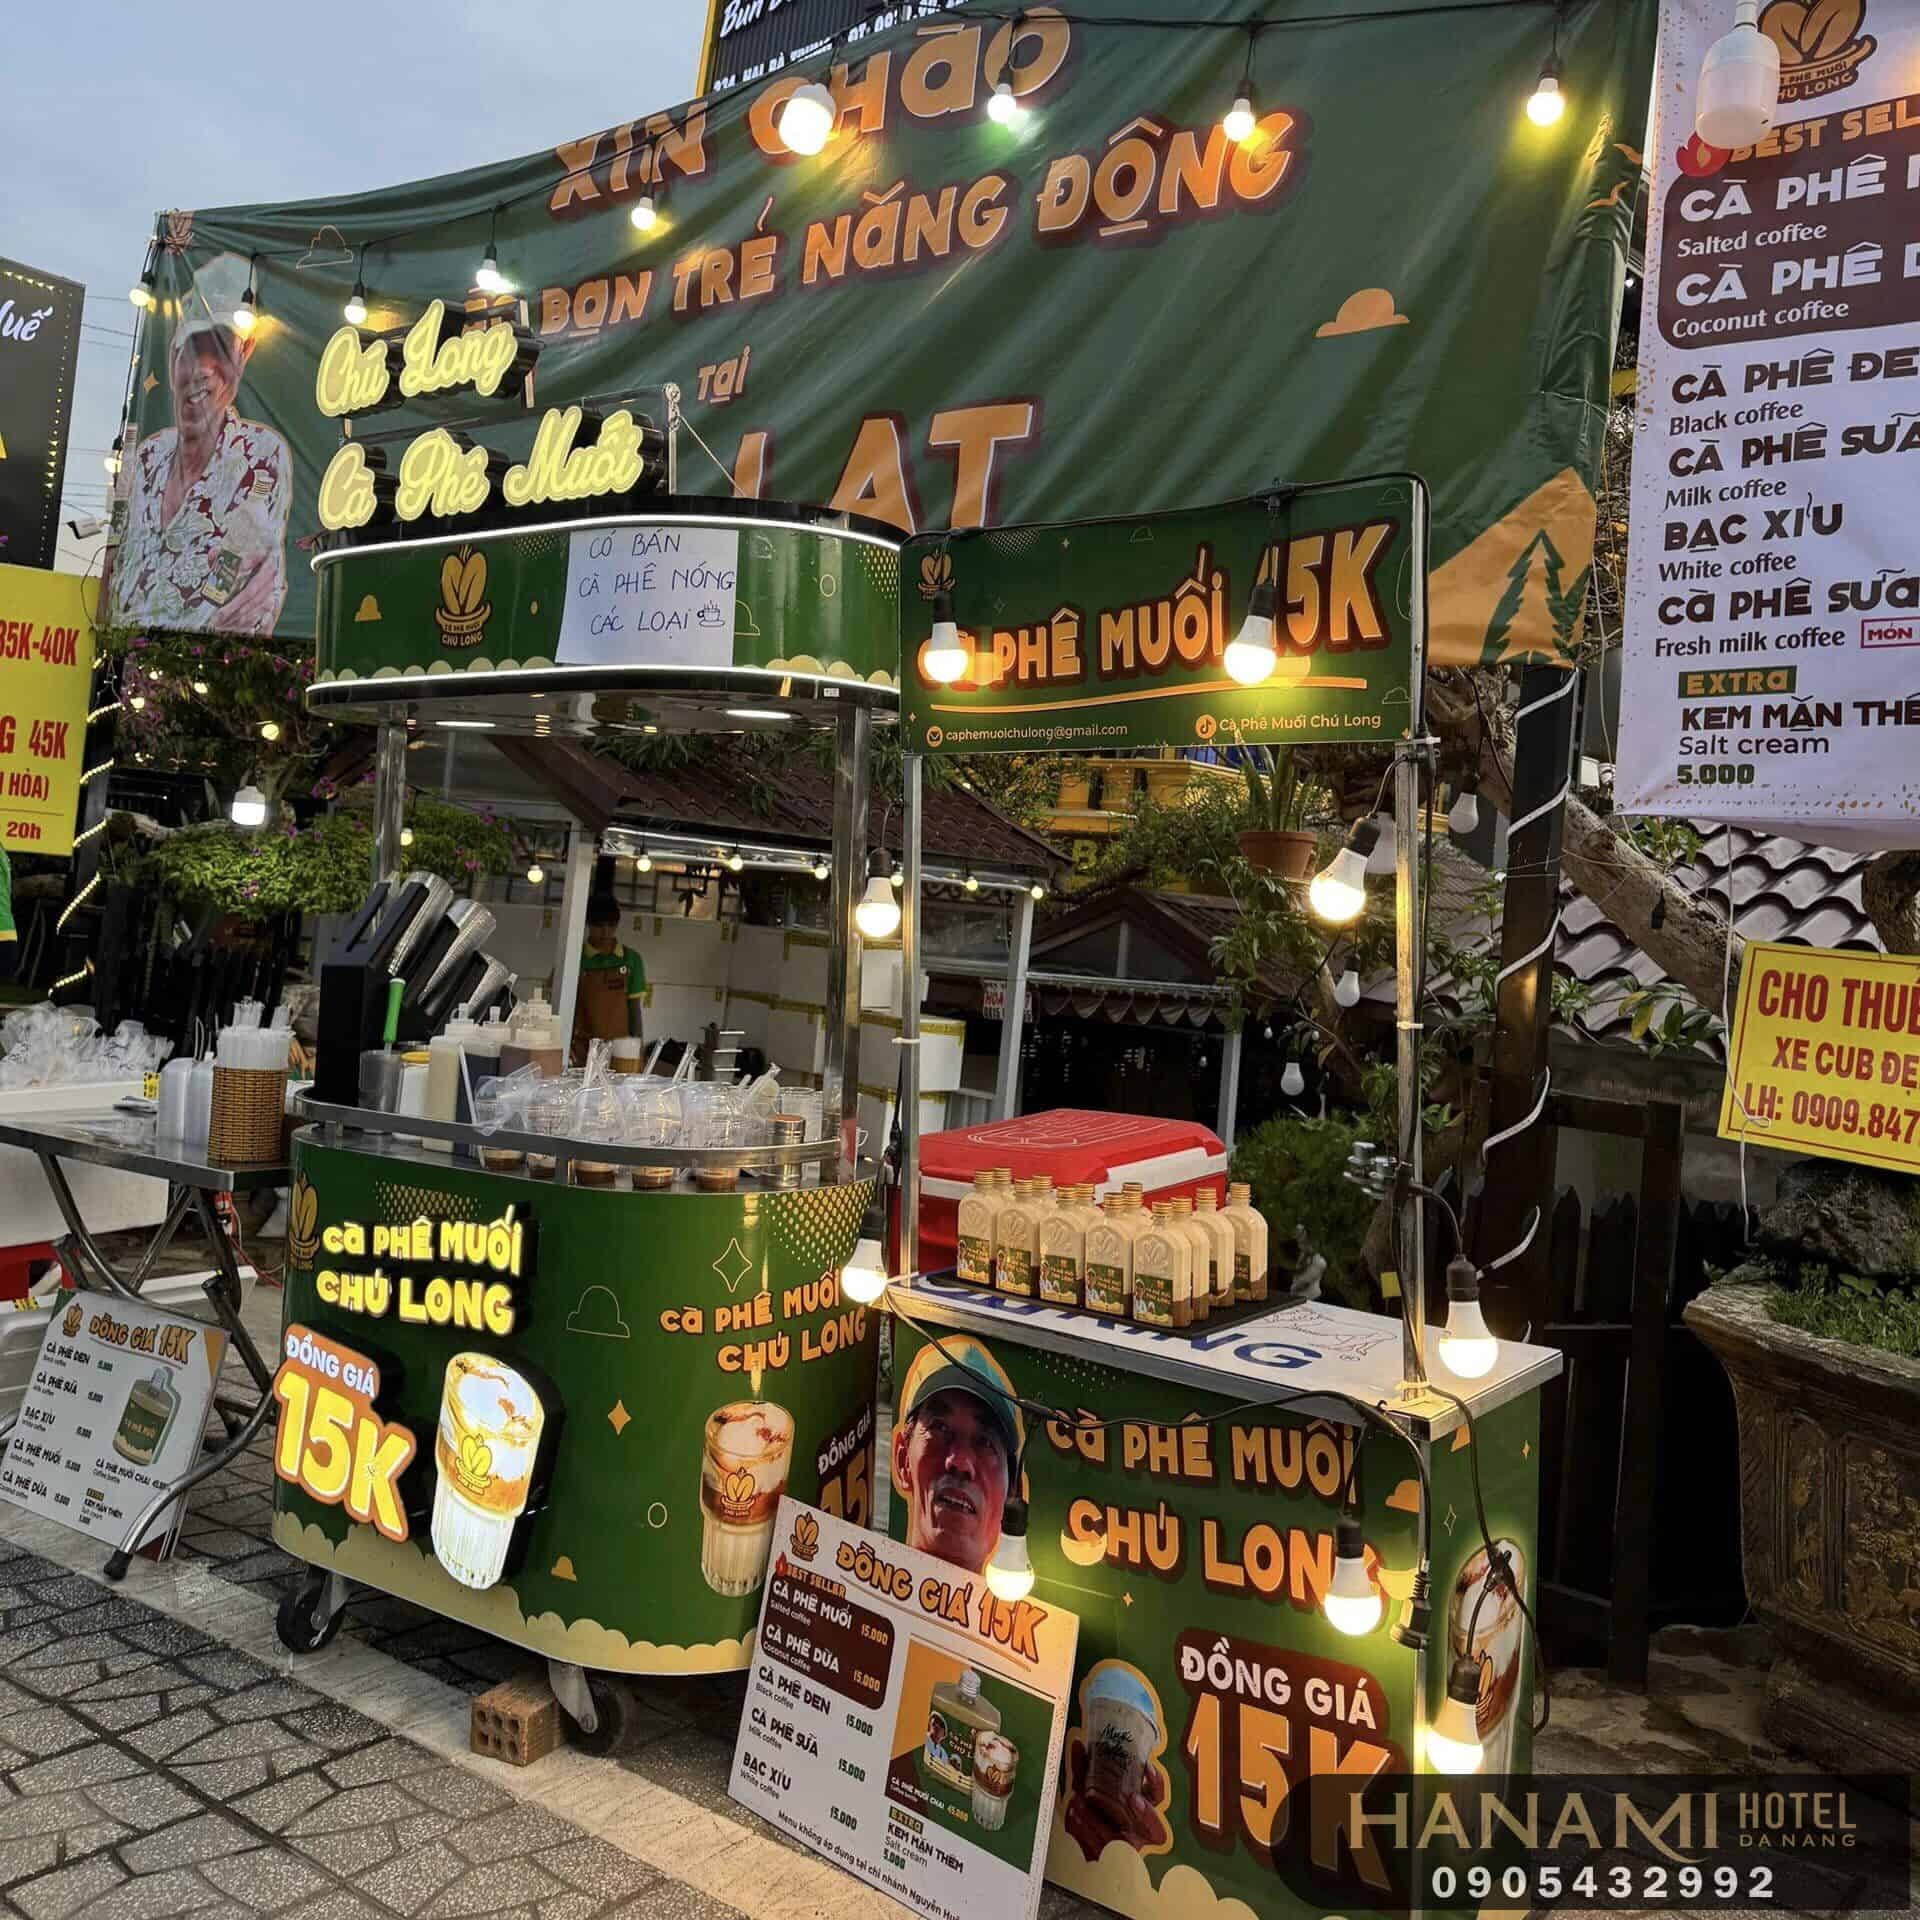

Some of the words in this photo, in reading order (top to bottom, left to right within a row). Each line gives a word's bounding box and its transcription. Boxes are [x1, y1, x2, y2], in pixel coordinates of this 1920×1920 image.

[551, 99, 710, 210] XIN
[1776, 153, 1888, 211] PHÊ
[1677, 231, 1748, 258] Salted
[1755, 223, 1828, 247] coffee
[1771, 241, 1884, 296] PHÊ
[1672, 309, 1768, 338] Coconut
[1774, 299, 1849, 324] coffee
[316, 326, 390, 417] Chú
[399, 298, 519, 397] Long
[1744, 348, 1834, 393] PHÊ
[1669, 410, 1728, 437] Black
[1733, 401, 1804, 427] coffee
[1741, 422, 1828, 469] PHÊ
[319, 442, 378, 530] Cà
[395, 428, 491, 521] Phê
[1663, 485, 1712, 511] Milk
[1718, 479, 1788, 502] coffee
[589, 529, 617, 559] CÓ
[631, 527, 681, 557] BÁN
[1664, 513, 1748, 553] BẠC
[578, 572, 600, 598] CÀ
[614, 562, 657, 595] PHÊ
[671, 561, 736, 591] NÓNG
[1658, 559, 1723, 582] White
[1729, 553, 1796, 576] coffee
[1729, 577, 1812, 621] PHÊ
[591, 604, 624, 635] CÁC
[637, 608, 693, 640] LOẠI
[1655, 635, 1711, 657] Fresh
[1719, 631, 1770, 655] milk
[1775, 627, 1846, 650] coffee
[1219, 718, 1237, 731] Cà
[1310, 712, 1340, 727] Chú
[1344, 713, 1382, 729] Long
[1681, 704, 1752, 732] KEM
[28, 719, 70, 760] 45K
[1679, 735, 1728, 755] Salt
[1737, 734, 1830, 754] cream
[1676, 763, 1755, 785] 5.000
[6, 821, 42, 840] 20h
[1758, 969, 1829, 1023] CHO
[1772, 1036, 1810, 1072] XE
[1815, 1042, 1876, 1081] CUB
[1743, 1082, 1784, 1120] LH:
[373, 1215, 434, 1260] PHÊ
[316, 1268, 390, 1318] CHÚ
[399, 1277, 515, 1336] LONG
[715, 1290, 773, 1333] PHÊ
[158, 1323, 197, 1364] 15K
[717, 1331, 790, 1372] CHÚ
[801, 1306, 867, 1361] LONG
[279, 1371, 411, 1536] 15K
[1123, 1412, 1213, 1478] PHÊ
[770, 1600, 791, 1619] Salted
[791, 1608, 812, 1627] coffee
[793, 1592, 818, 1613] PHÊ
[861, 1624, 889, 1646] 15.000
[919, 1577, 973, 1628] GIÁ
[979, 1589, 1048, 1665] 15K
[786, 1636, 811, 1659] PHÊ
[853, 1669, 881, 1693] 15.000
[790, 1653, 811, 1673] coffee
[1181, 1637, 1292, 1705] ĐỒNG
[1303, 1677, 1377, 1730] GIÁ
[775, 1692, 795, 1711] coffee
[777, 1677, 802, 1699] PHÊ
[846, 1713, 873, 1737] 15.000
[762, 1731, 783, 1752] coffee
[770, 1719, 795, 1742] PHÊ
[838, 1757, 866, 1783] 15.000
[759, 1778, 780, 1800] coffee
[778, 1810, 798, 1829] Menu
[798, 1822, 822, 1846] không
[823, 1837, 833, 1852] áp
[834, 1844, 855, 1865] dụng
[829, 1805, 858, 1831] 15.000
[887, 1822, 910, 1841] KEM
[885, 1836, 900, 1851] Salt
[902, 1847, 928, 1868] cream
